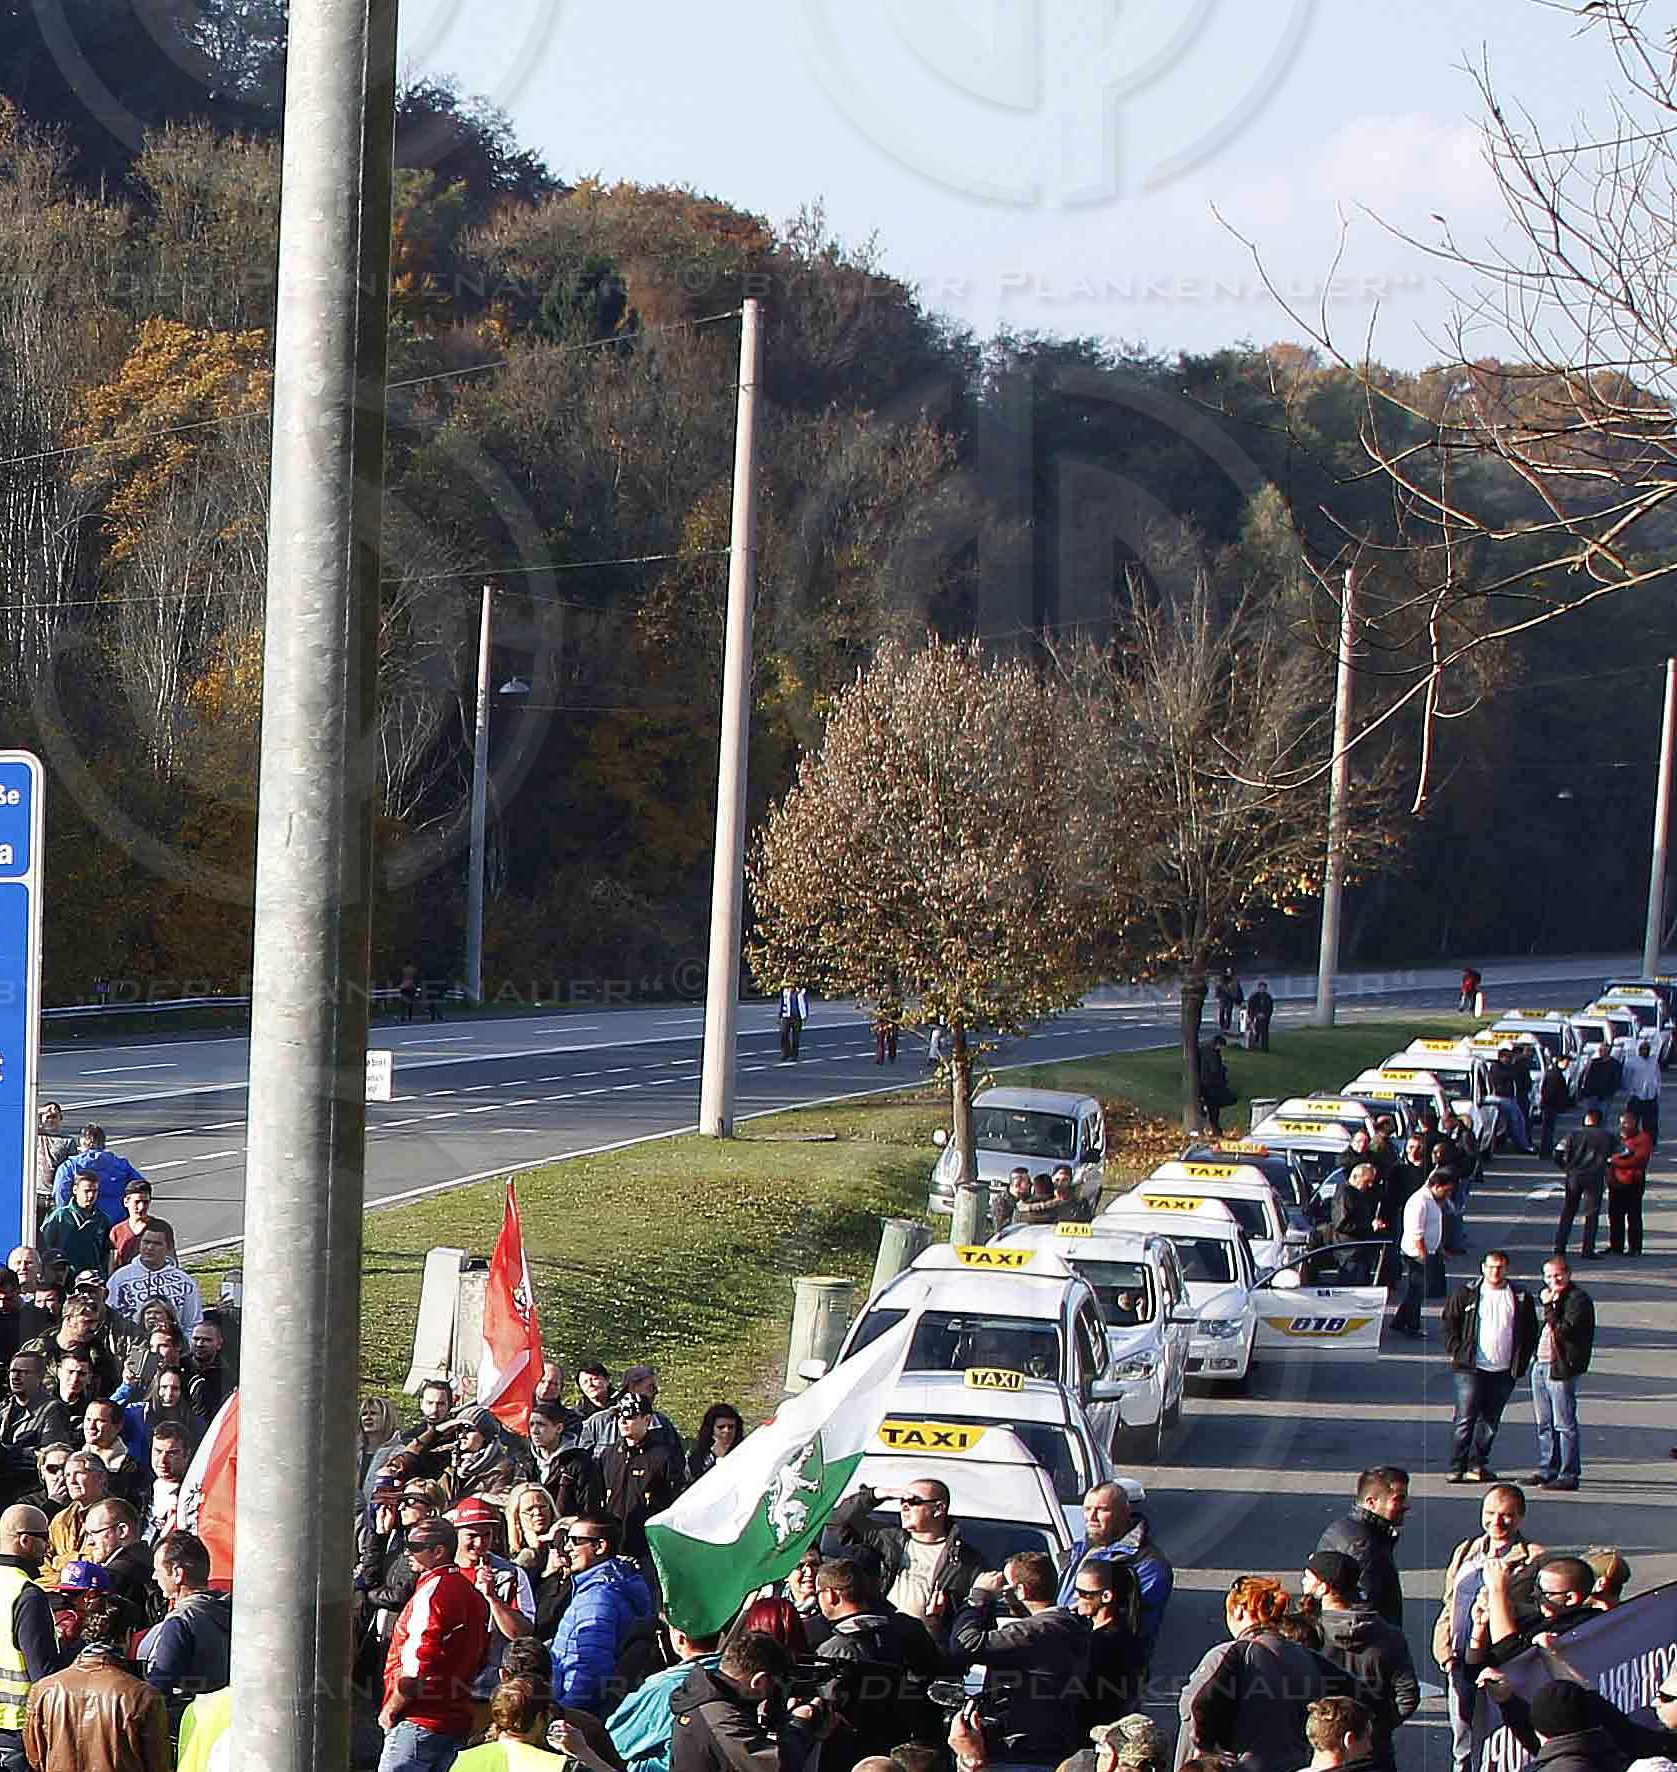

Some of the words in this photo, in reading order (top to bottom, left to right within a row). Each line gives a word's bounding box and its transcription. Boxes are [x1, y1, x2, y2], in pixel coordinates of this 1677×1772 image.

[1188, 1167, 1232, 1177] TAXI
[1147, 1199, 1195, 1210] TAXI
[962, 1251, 1024, 1265] TAXI
[974, 1371, 1018, 1387] TAXI
[882, 1428, 968, 1448] TAXI
